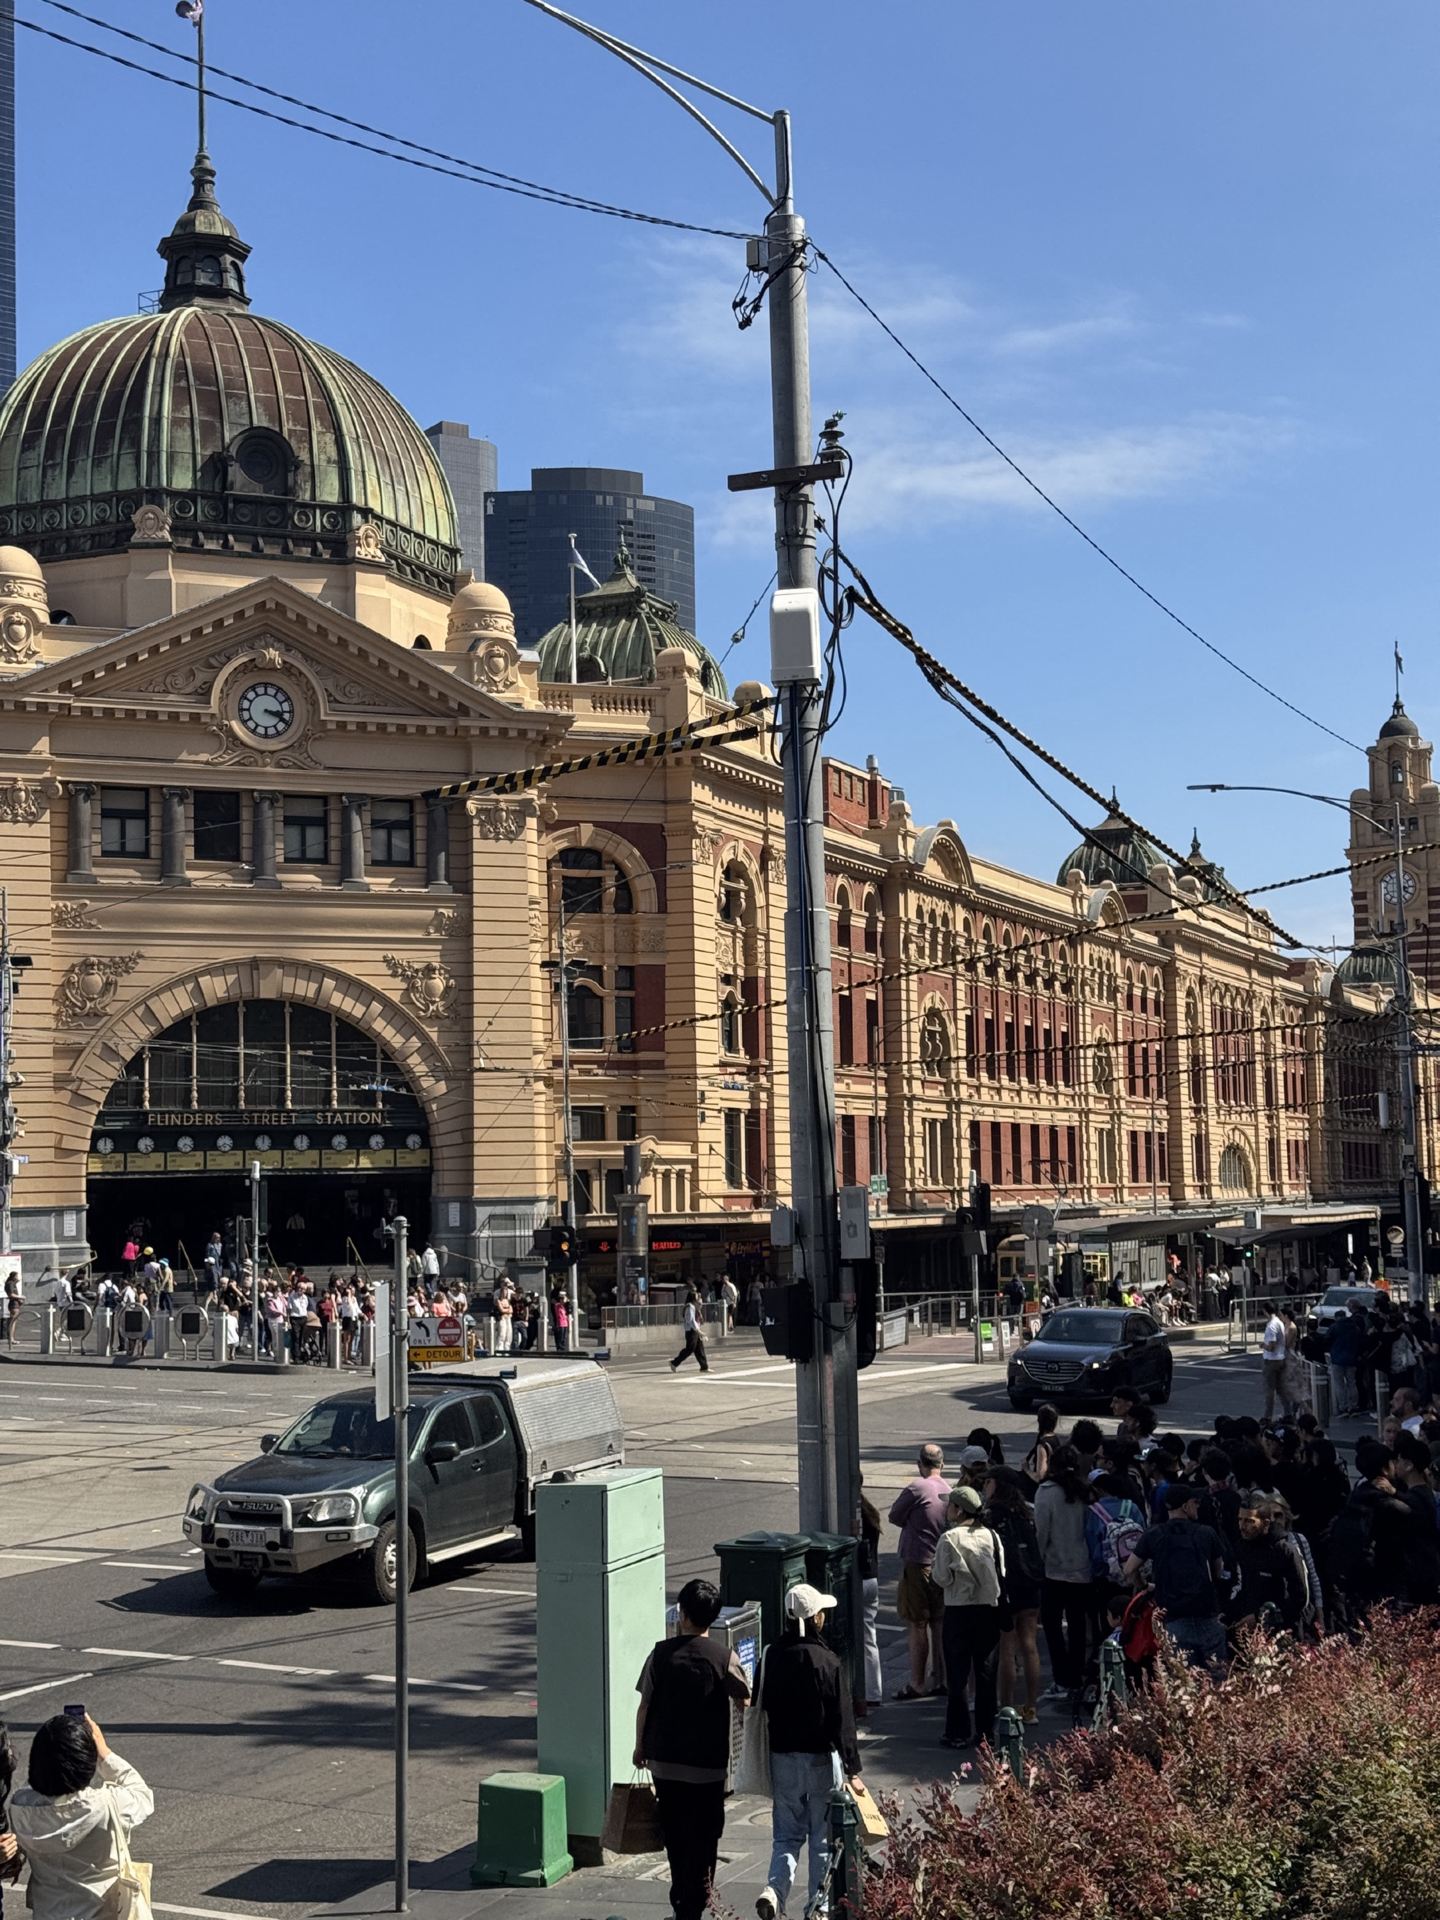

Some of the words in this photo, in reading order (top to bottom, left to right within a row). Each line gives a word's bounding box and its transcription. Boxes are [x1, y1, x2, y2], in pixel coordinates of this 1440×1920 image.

[148, 1113, 223, 1126] FLINDERS
[242, 1112, 298, 1125] STREET
[315, 1112, 382, 1125] STATION
[427, 1350, 461, 1358] DETOUR
[242, 1502, 274, 1511] ISUZU
